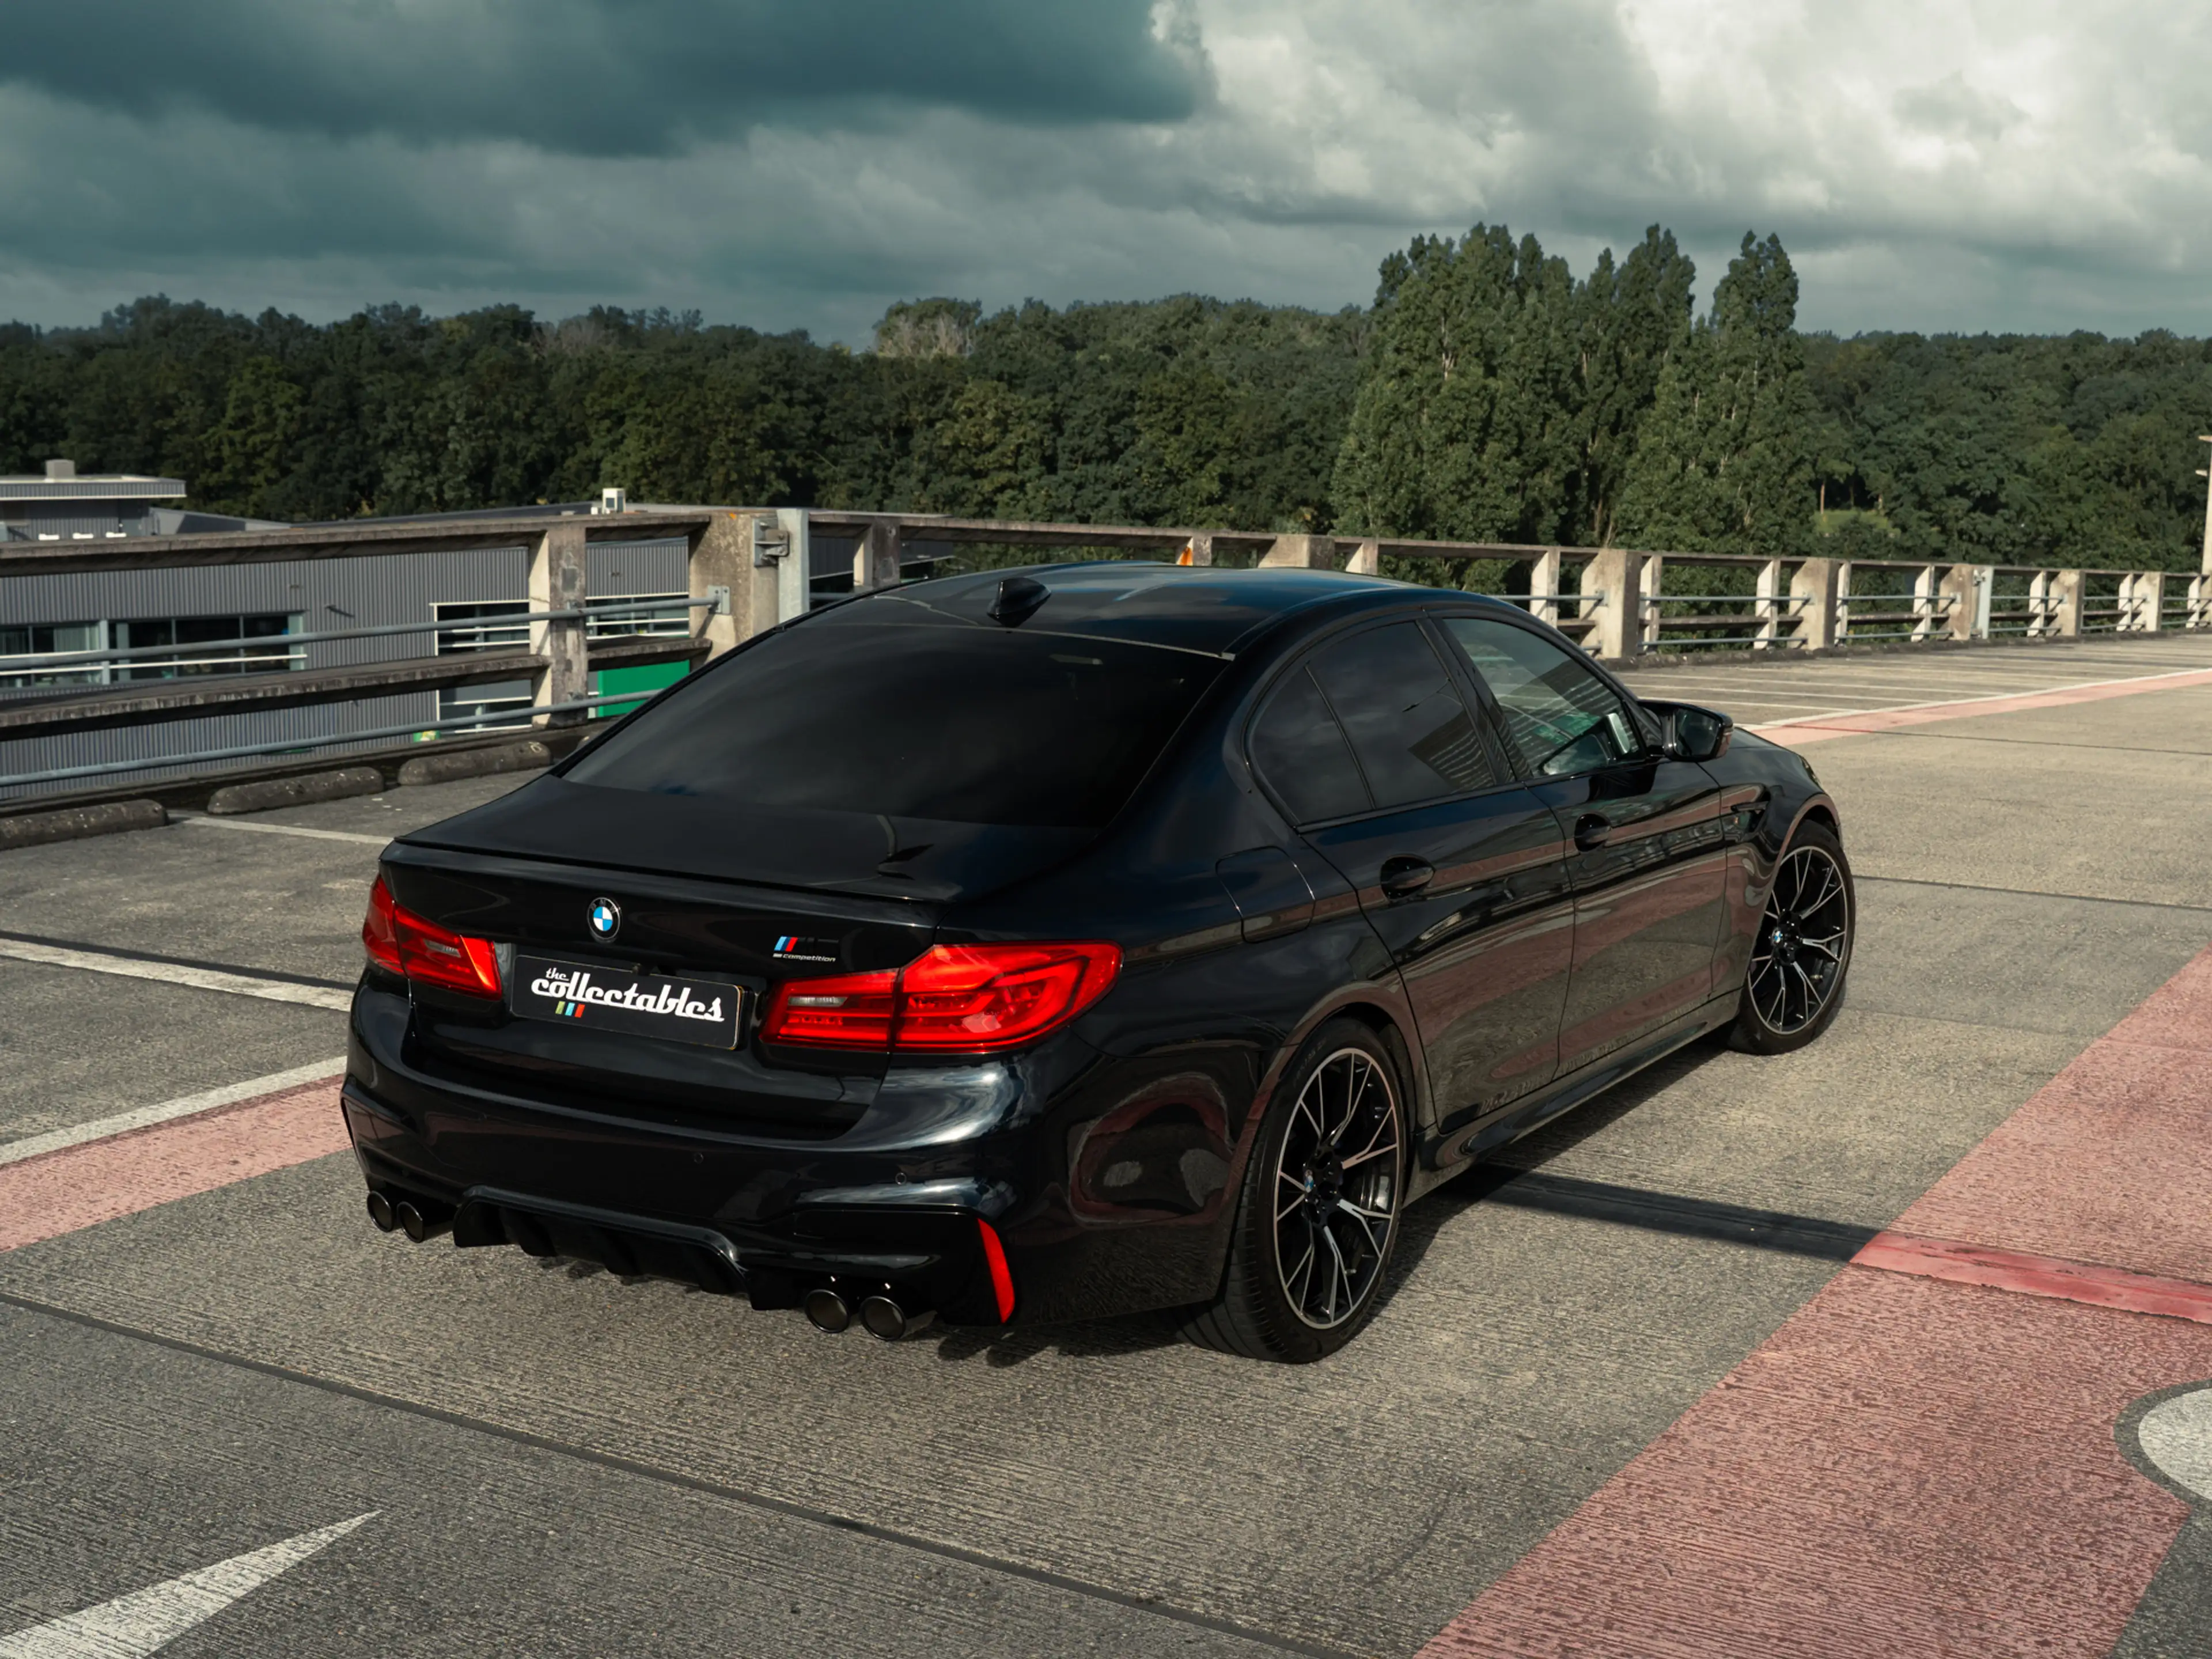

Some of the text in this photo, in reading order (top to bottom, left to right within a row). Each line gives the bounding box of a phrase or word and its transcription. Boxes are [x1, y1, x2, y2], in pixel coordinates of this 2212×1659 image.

[783, 954, 836, 962] competition
[546, 968, 569, 980] the
[531, 971, 725, 1022] collectables
